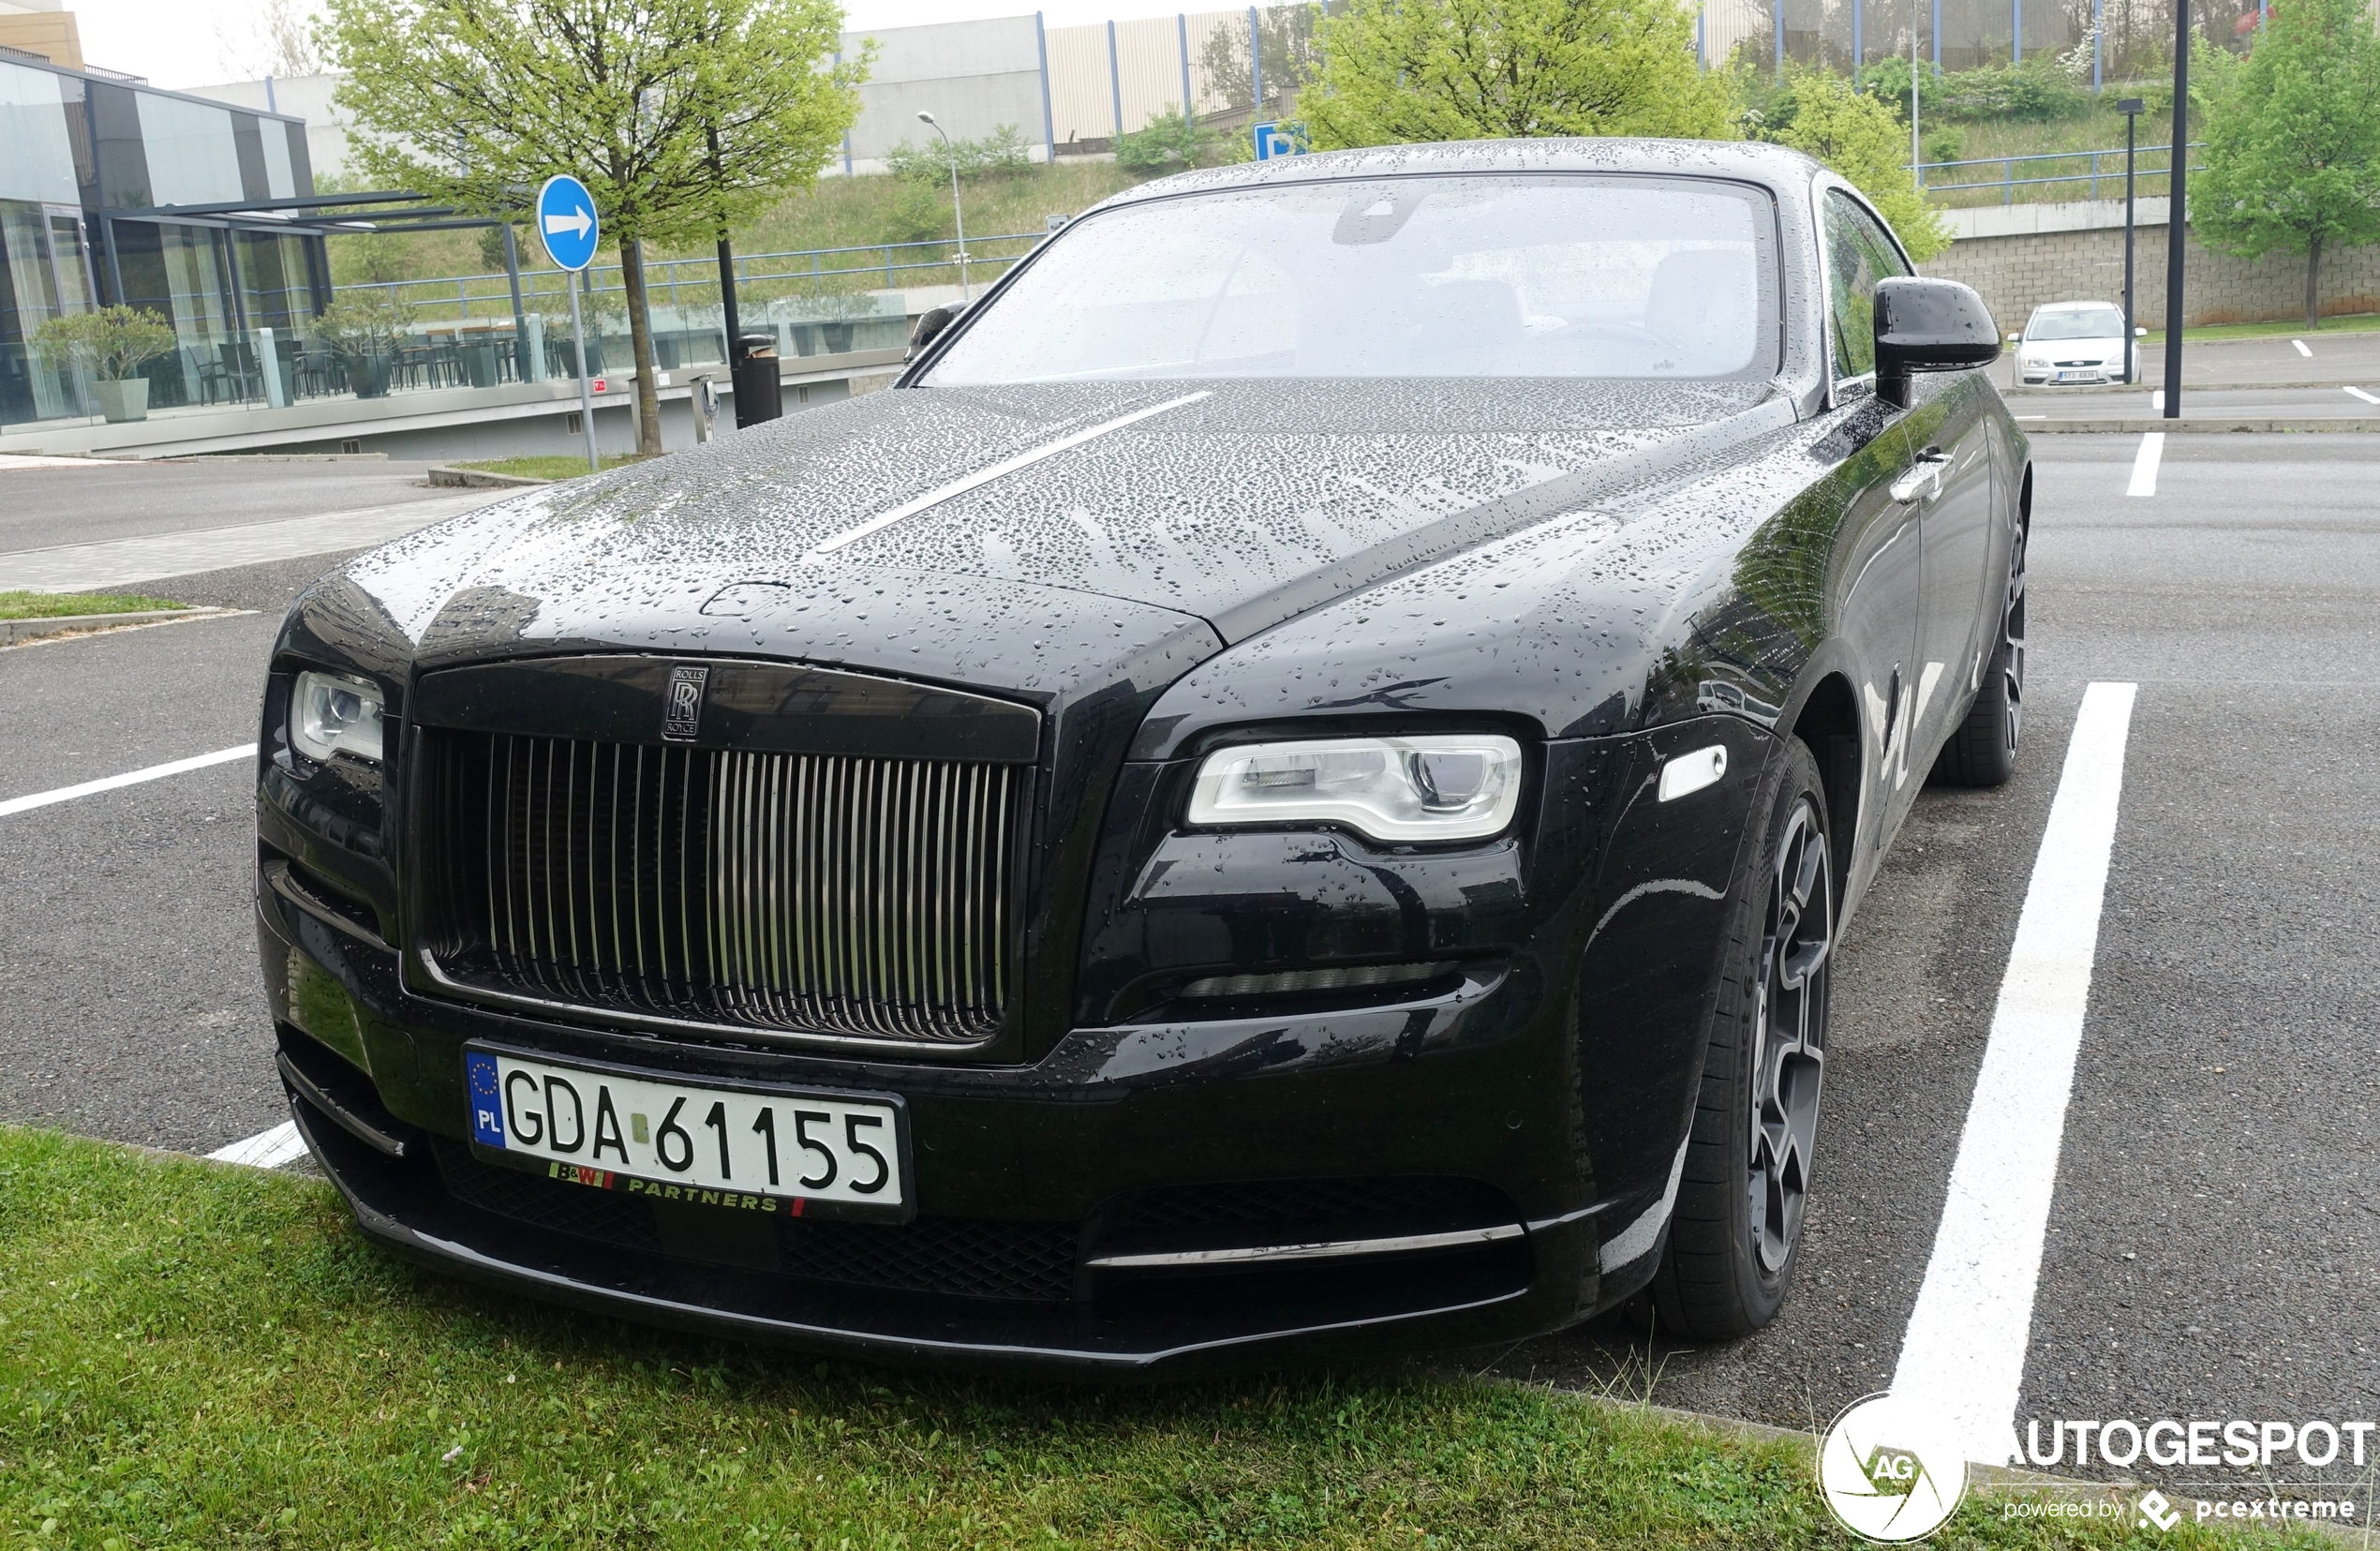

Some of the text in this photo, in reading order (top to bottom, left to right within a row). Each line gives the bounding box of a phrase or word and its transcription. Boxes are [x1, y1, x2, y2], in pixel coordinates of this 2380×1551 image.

[676, 670, 705, 679] ROLLS
[666, 723, 695, 733] ROYCE
[478, 1109, 501, 1134] PL
[504, 1069, 890, 1195] GDA 61155
[558, 1164, 778, 1213] B&W PARTNERS
